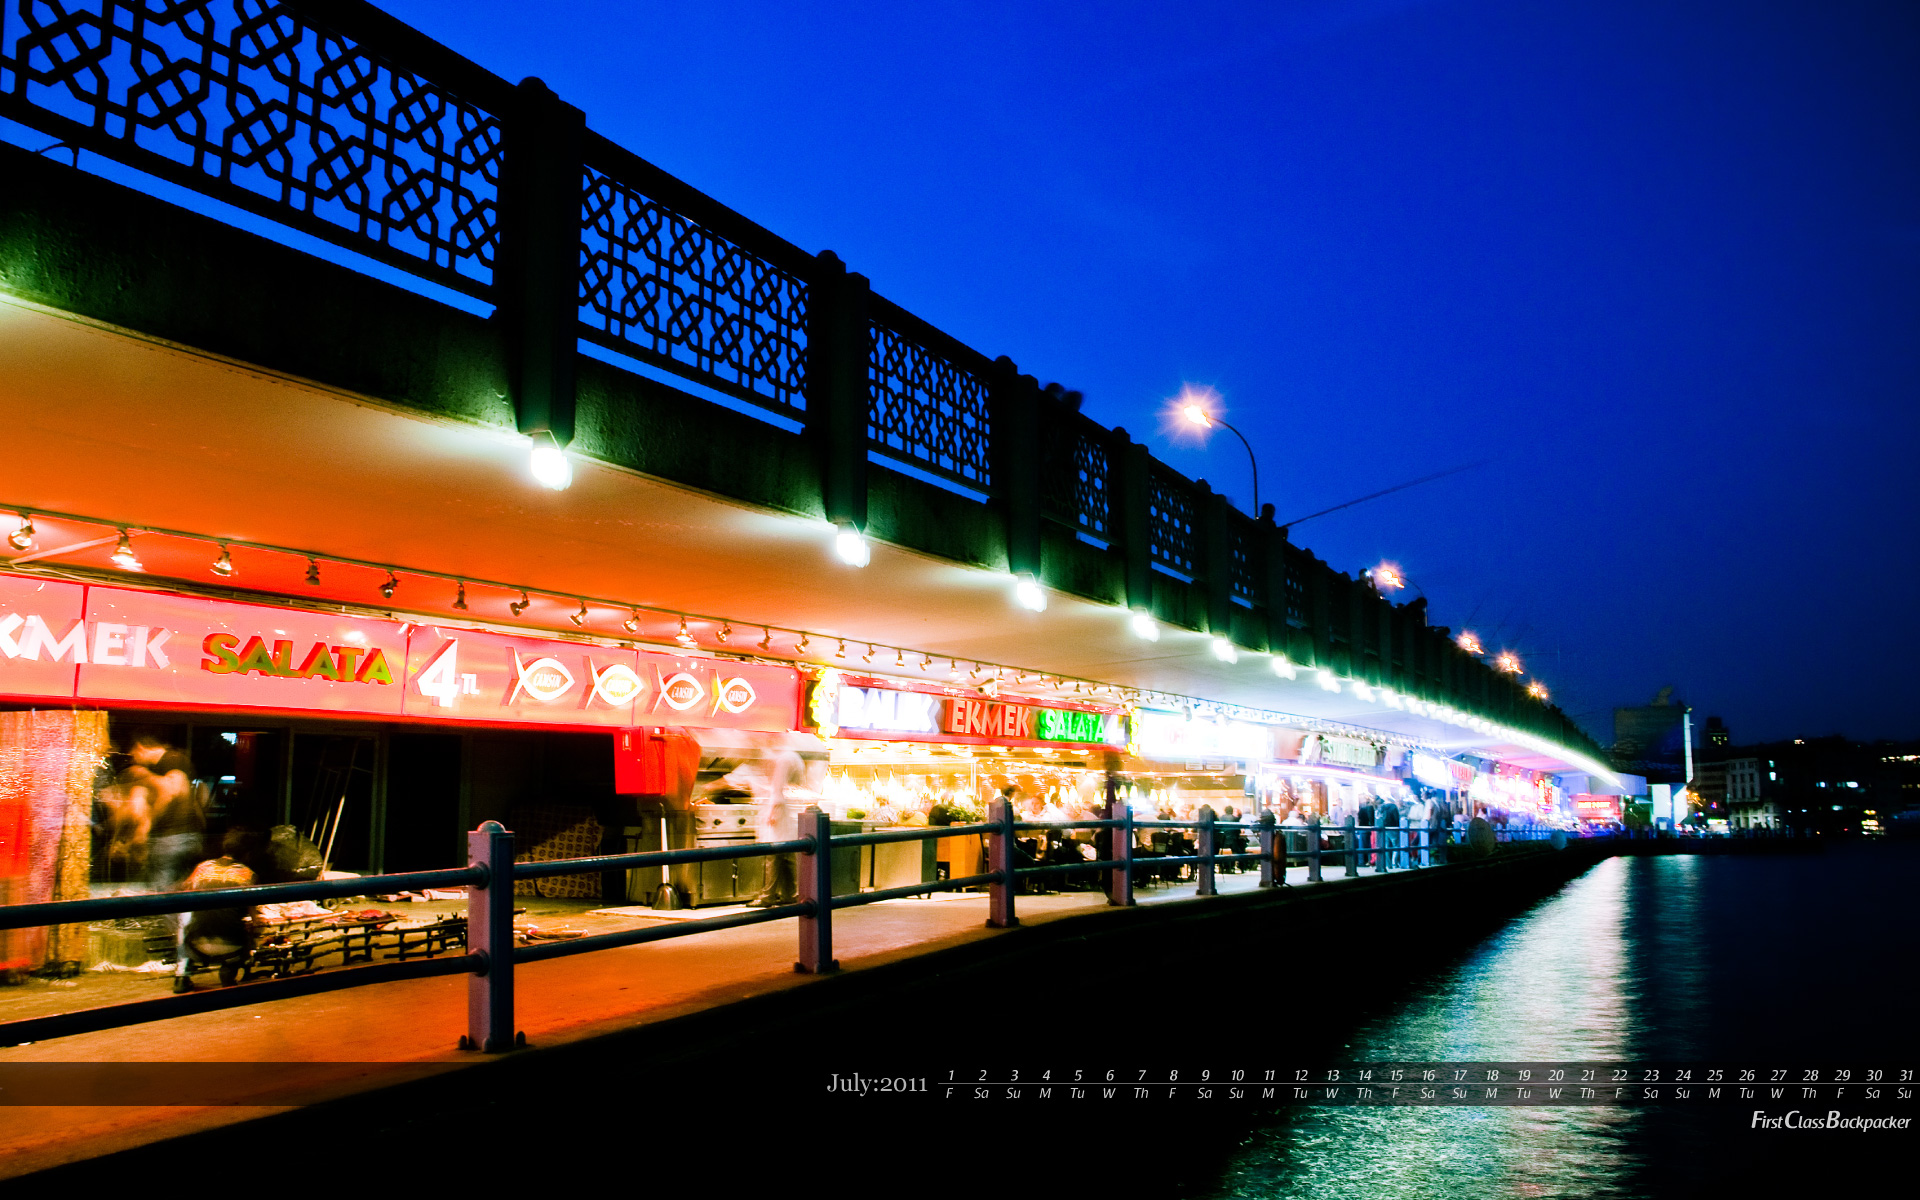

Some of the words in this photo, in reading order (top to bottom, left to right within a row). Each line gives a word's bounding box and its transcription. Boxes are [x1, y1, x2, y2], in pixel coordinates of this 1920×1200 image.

[201, 632, 394, 685] SALATA
[412, 637, 460, 707] 4
[460, 673, 480, 695] TL
[947, 699, 1031, 737] EKMEK
[1041, 708, 1104, 742] SALATA
